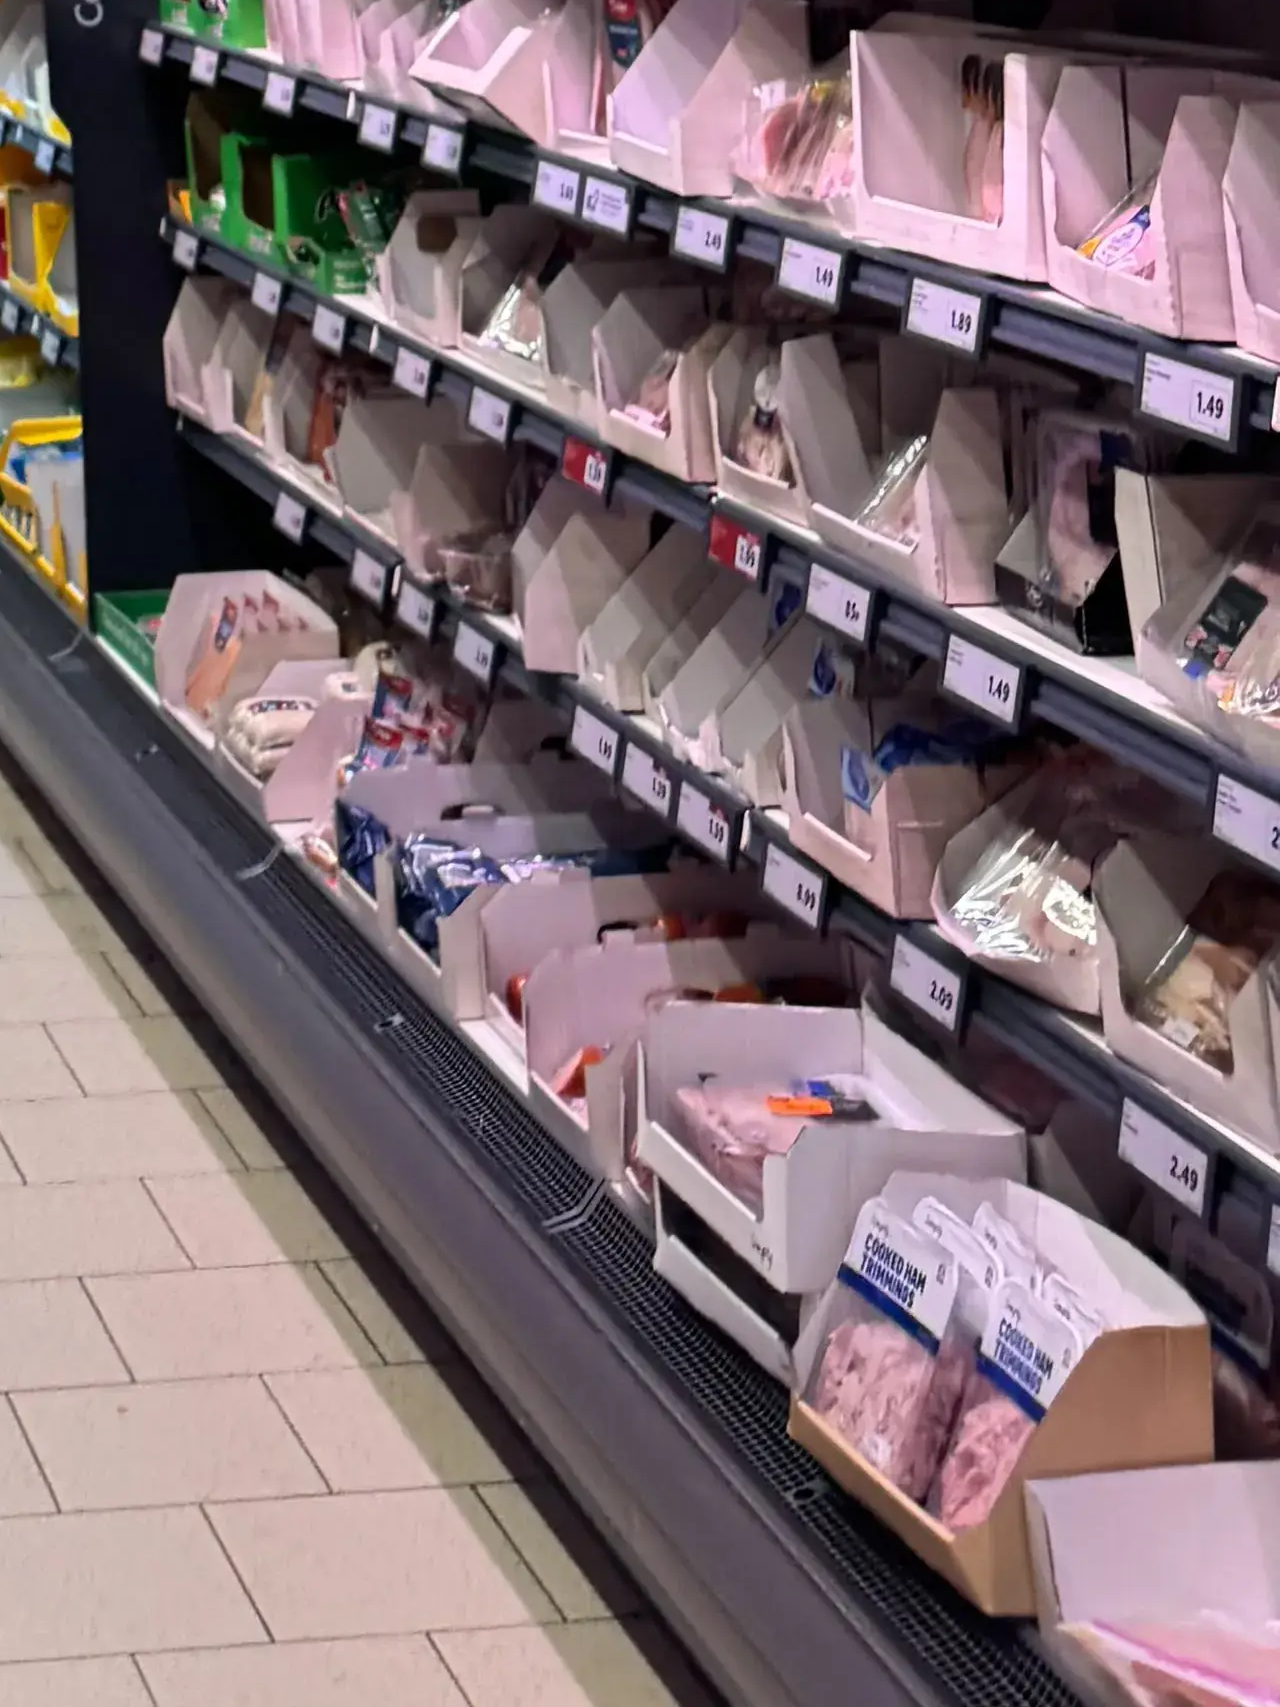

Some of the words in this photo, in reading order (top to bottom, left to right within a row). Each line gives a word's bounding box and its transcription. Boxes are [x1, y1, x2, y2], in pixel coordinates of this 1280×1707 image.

[815, 265, 834, 288] 1.49
[951, 309, 972, 334] 1.89
[1196, 390, 1225, 420] 1.49
[988, 675, 1011, 704] 1.49
[929, 978, 954, 1011] 2.09
[1168, 1153, 1200, 1192] 2.49
[859, 1250, 916, 1309] TRIMMINGS
[863, 1232, 905, 1279] COOKED
[903, 1264, 928, 1297] HAM
[998, 1317, 1035, 1361] COOKED
[1032, 1345, 1054, 1381] HAM
